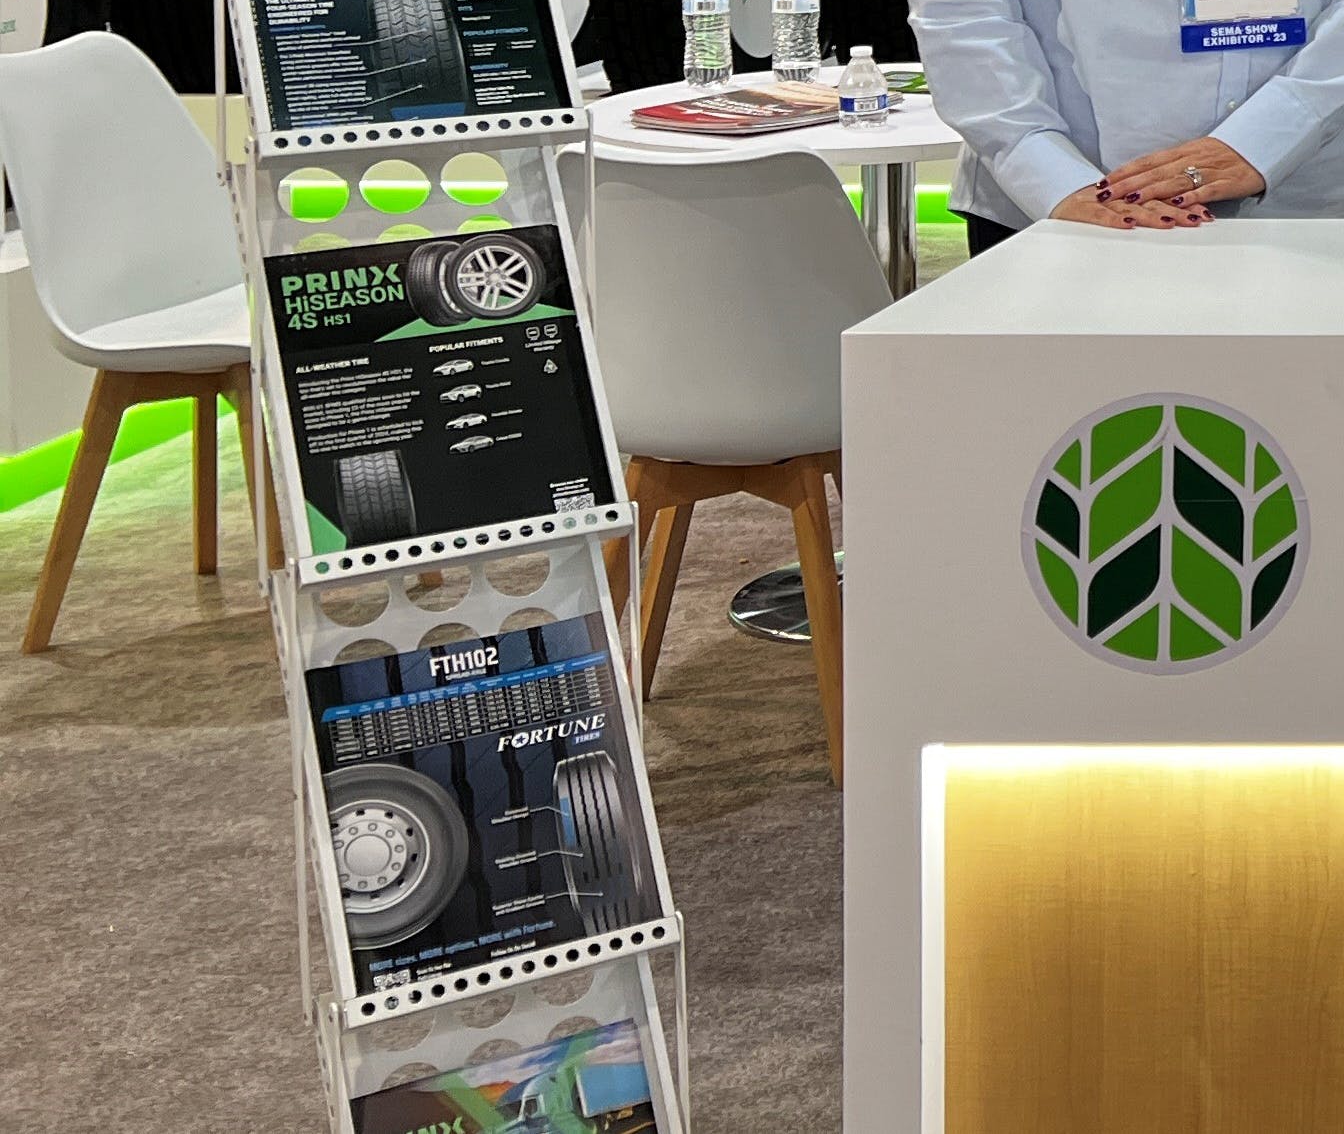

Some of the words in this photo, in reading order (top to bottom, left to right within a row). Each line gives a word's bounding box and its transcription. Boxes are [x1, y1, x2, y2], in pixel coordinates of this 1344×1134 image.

[1203, 35, 1264, 47] EXHIBITOR
[1273, 32, 1286, 42] 23
[1210, 25, 1242, 37] SEMA
[1244, 24, 1278, 35] SHOW
[281, 263, 401, 297] PRINX
[285, 284, 404, 315] HiSEASON
[288, 312, 318, 330] 4S
[323, 313, 351, 326] HS1
[429, 342, 465, 353] POPULAR
[466, 336, 504, 348] FITMENTS
[429, 647, 499, 677] FTH102
[497, 713, 606, 753] FORTUNE
